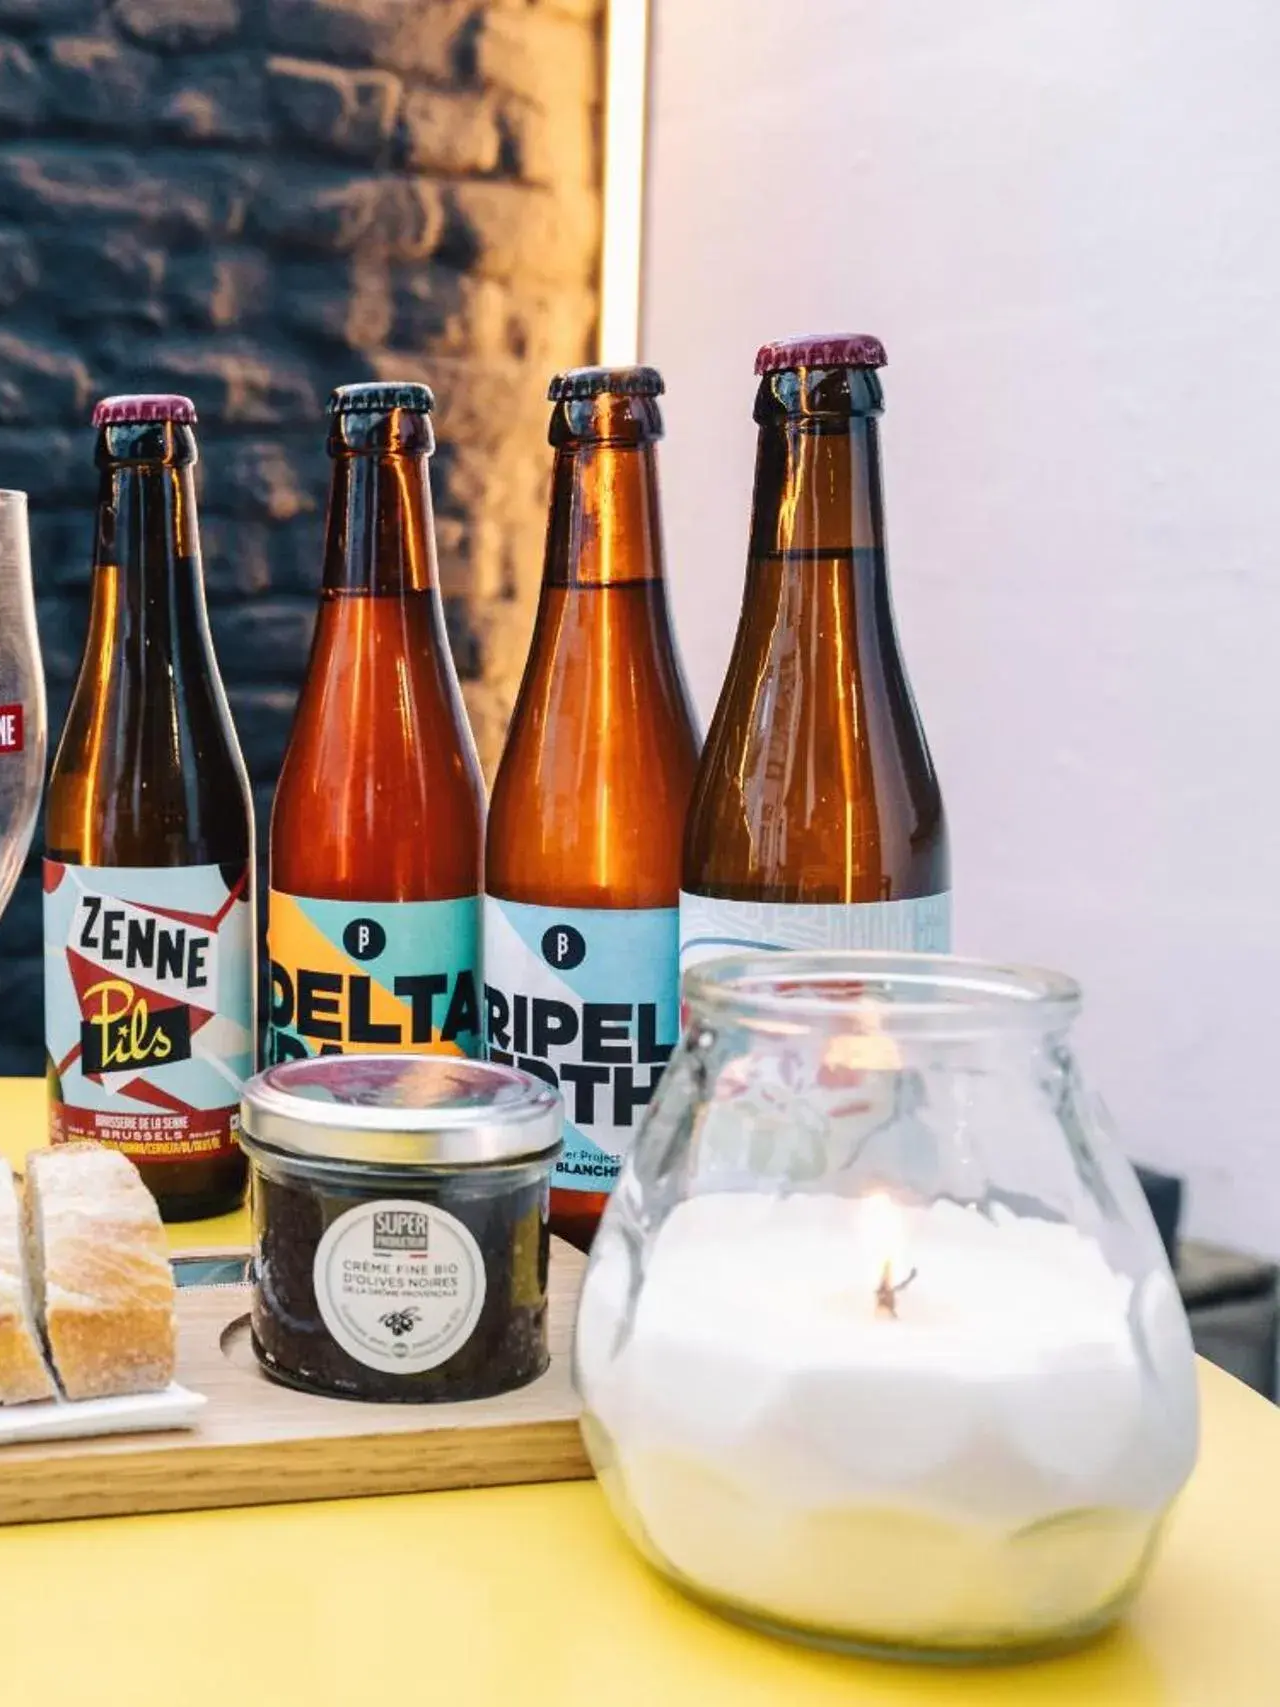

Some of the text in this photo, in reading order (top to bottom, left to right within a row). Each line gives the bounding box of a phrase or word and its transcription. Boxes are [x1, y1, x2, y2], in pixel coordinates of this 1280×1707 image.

[80, 895, 210, 989] ZENNE
[270, 959, 482, 1044] DELTA
[82, 979, 171, 1067] Pils
[101, 1129, 184, 1141] BRUSSELS
[375, 1213, 427, 1236] SUPER
[343, 1272, 458, 1288] D'OLIVES NOIRES
[396, 1263, 429, 1275] FINE
[434, 1262, 459, 1274] BIO
